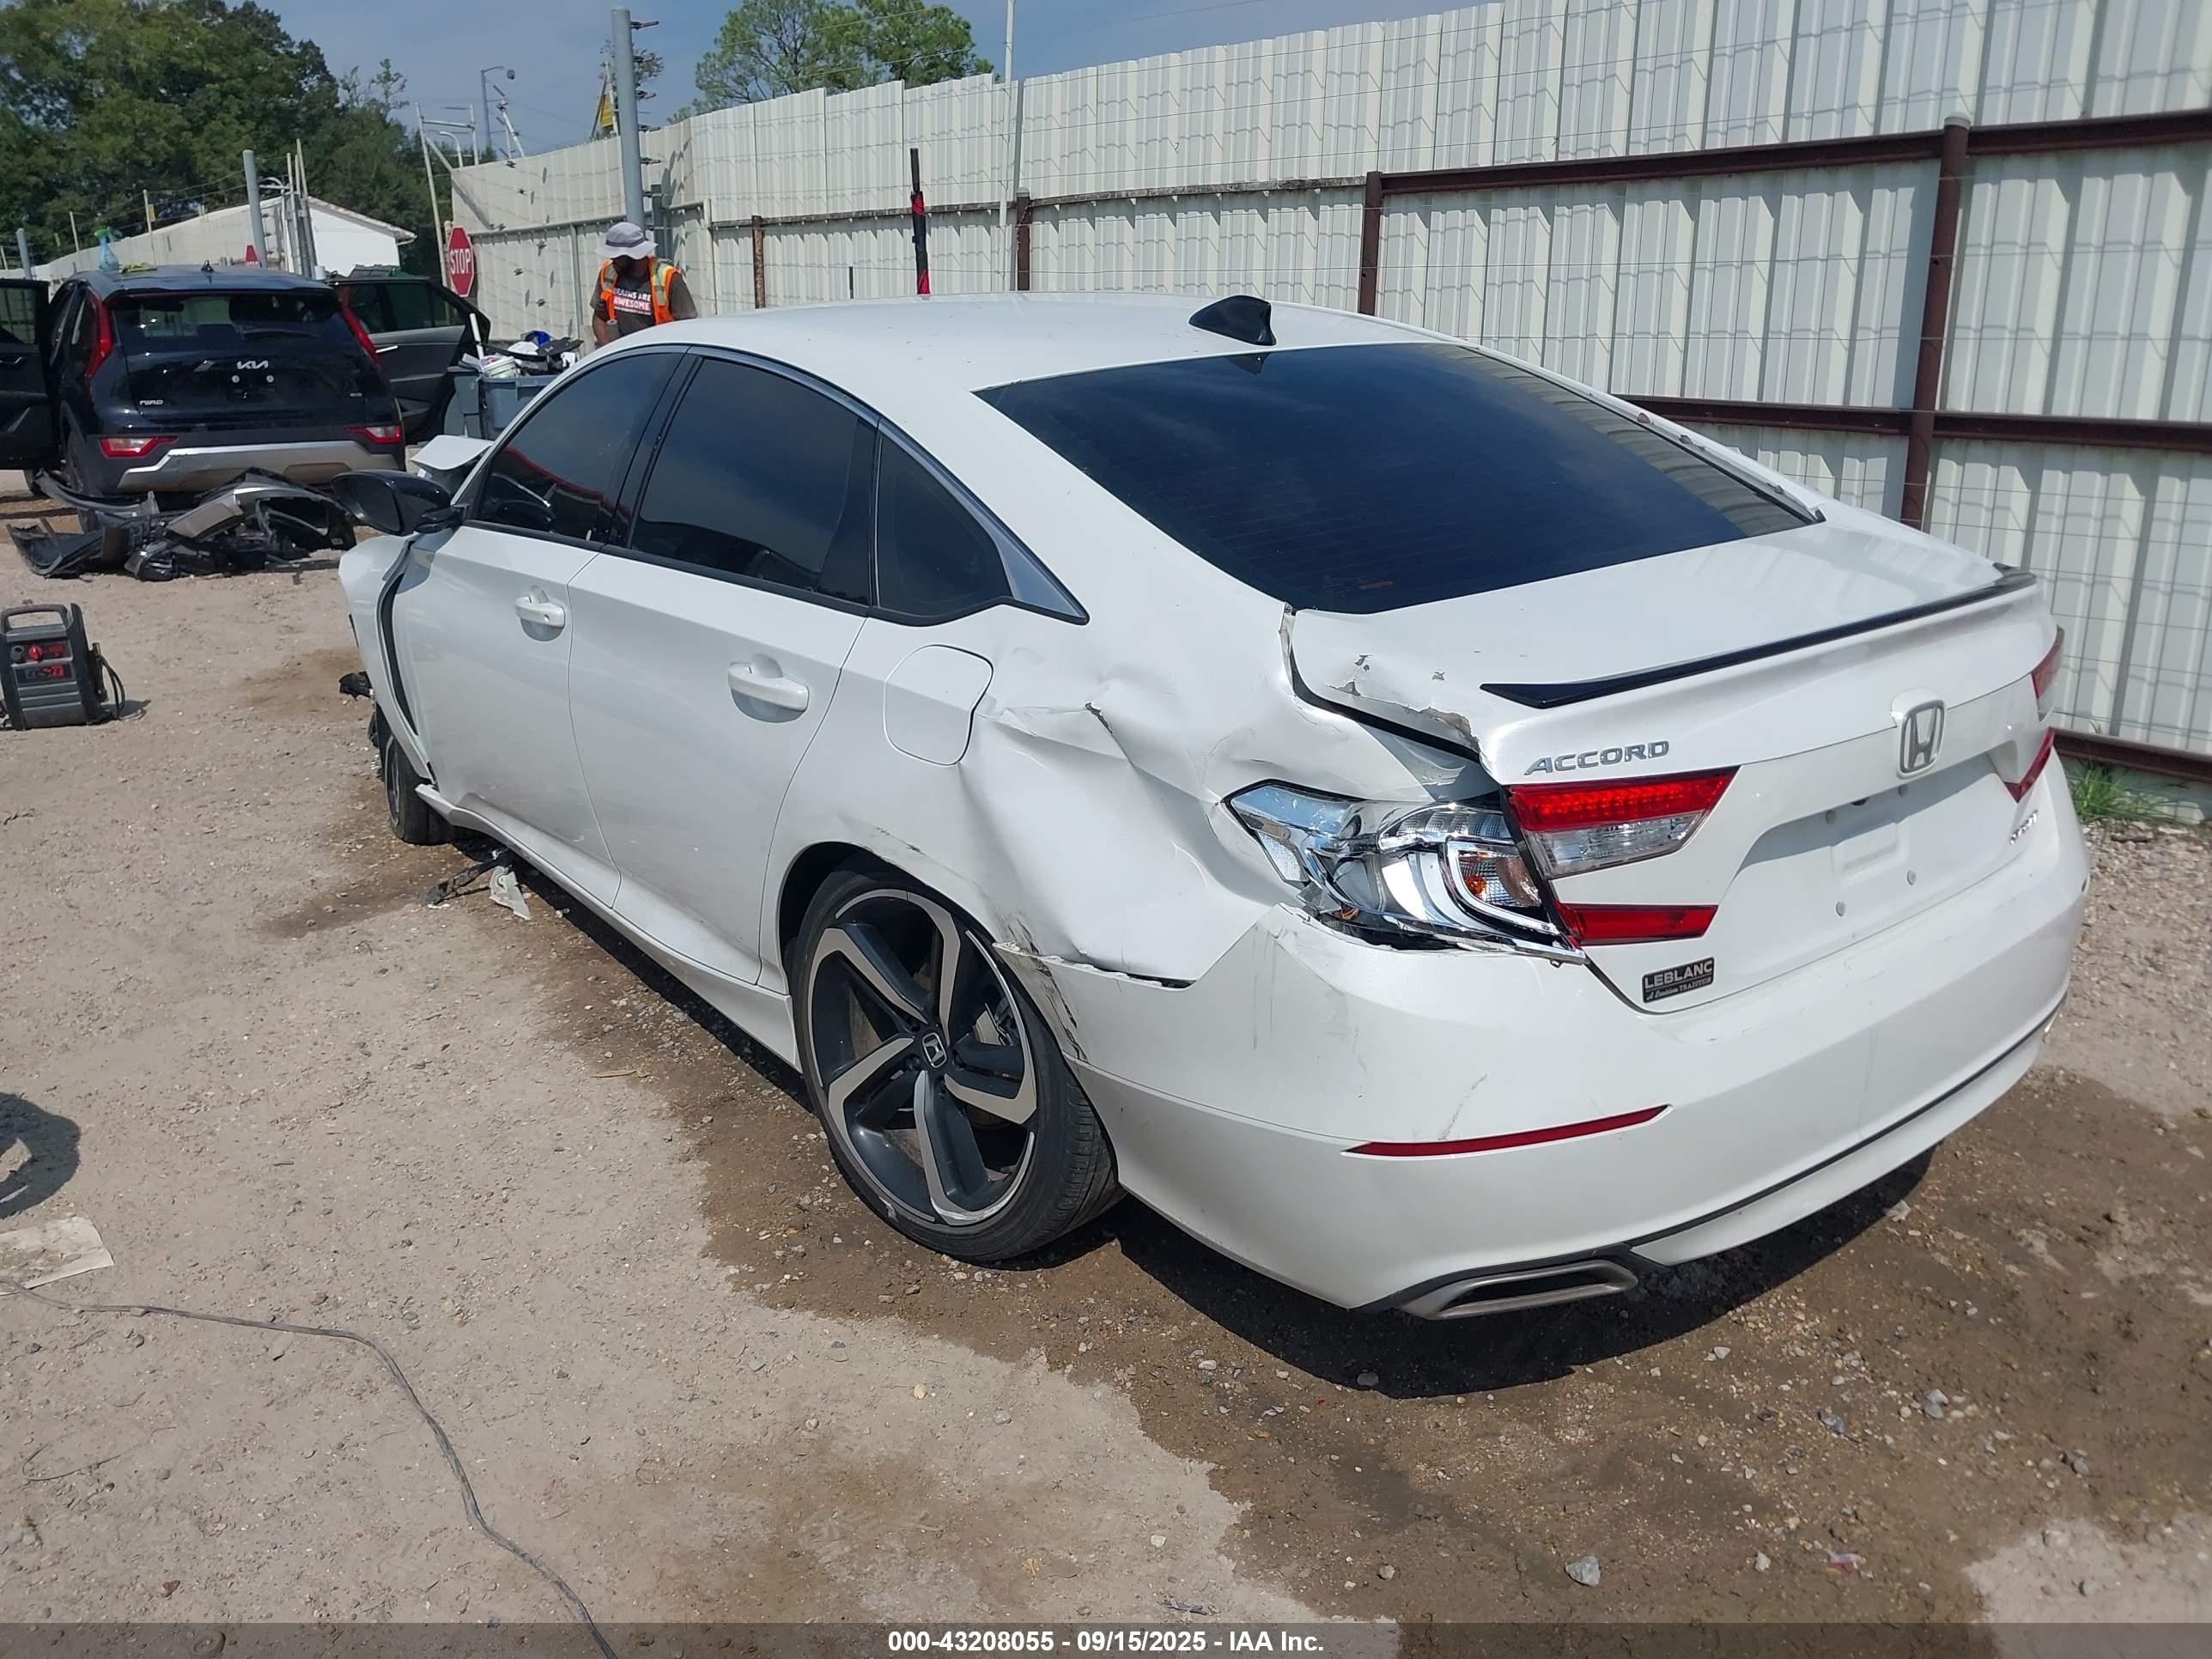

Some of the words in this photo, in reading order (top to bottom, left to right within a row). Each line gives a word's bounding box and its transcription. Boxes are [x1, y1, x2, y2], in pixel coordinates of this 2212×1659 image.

[450, 248, 471, 275] STOP
[613, 295, 651, 311] AWESOME
[1523, 740, 1670, 775] ACCORD
[1644, 960, 1713, 989] LEBLANC
